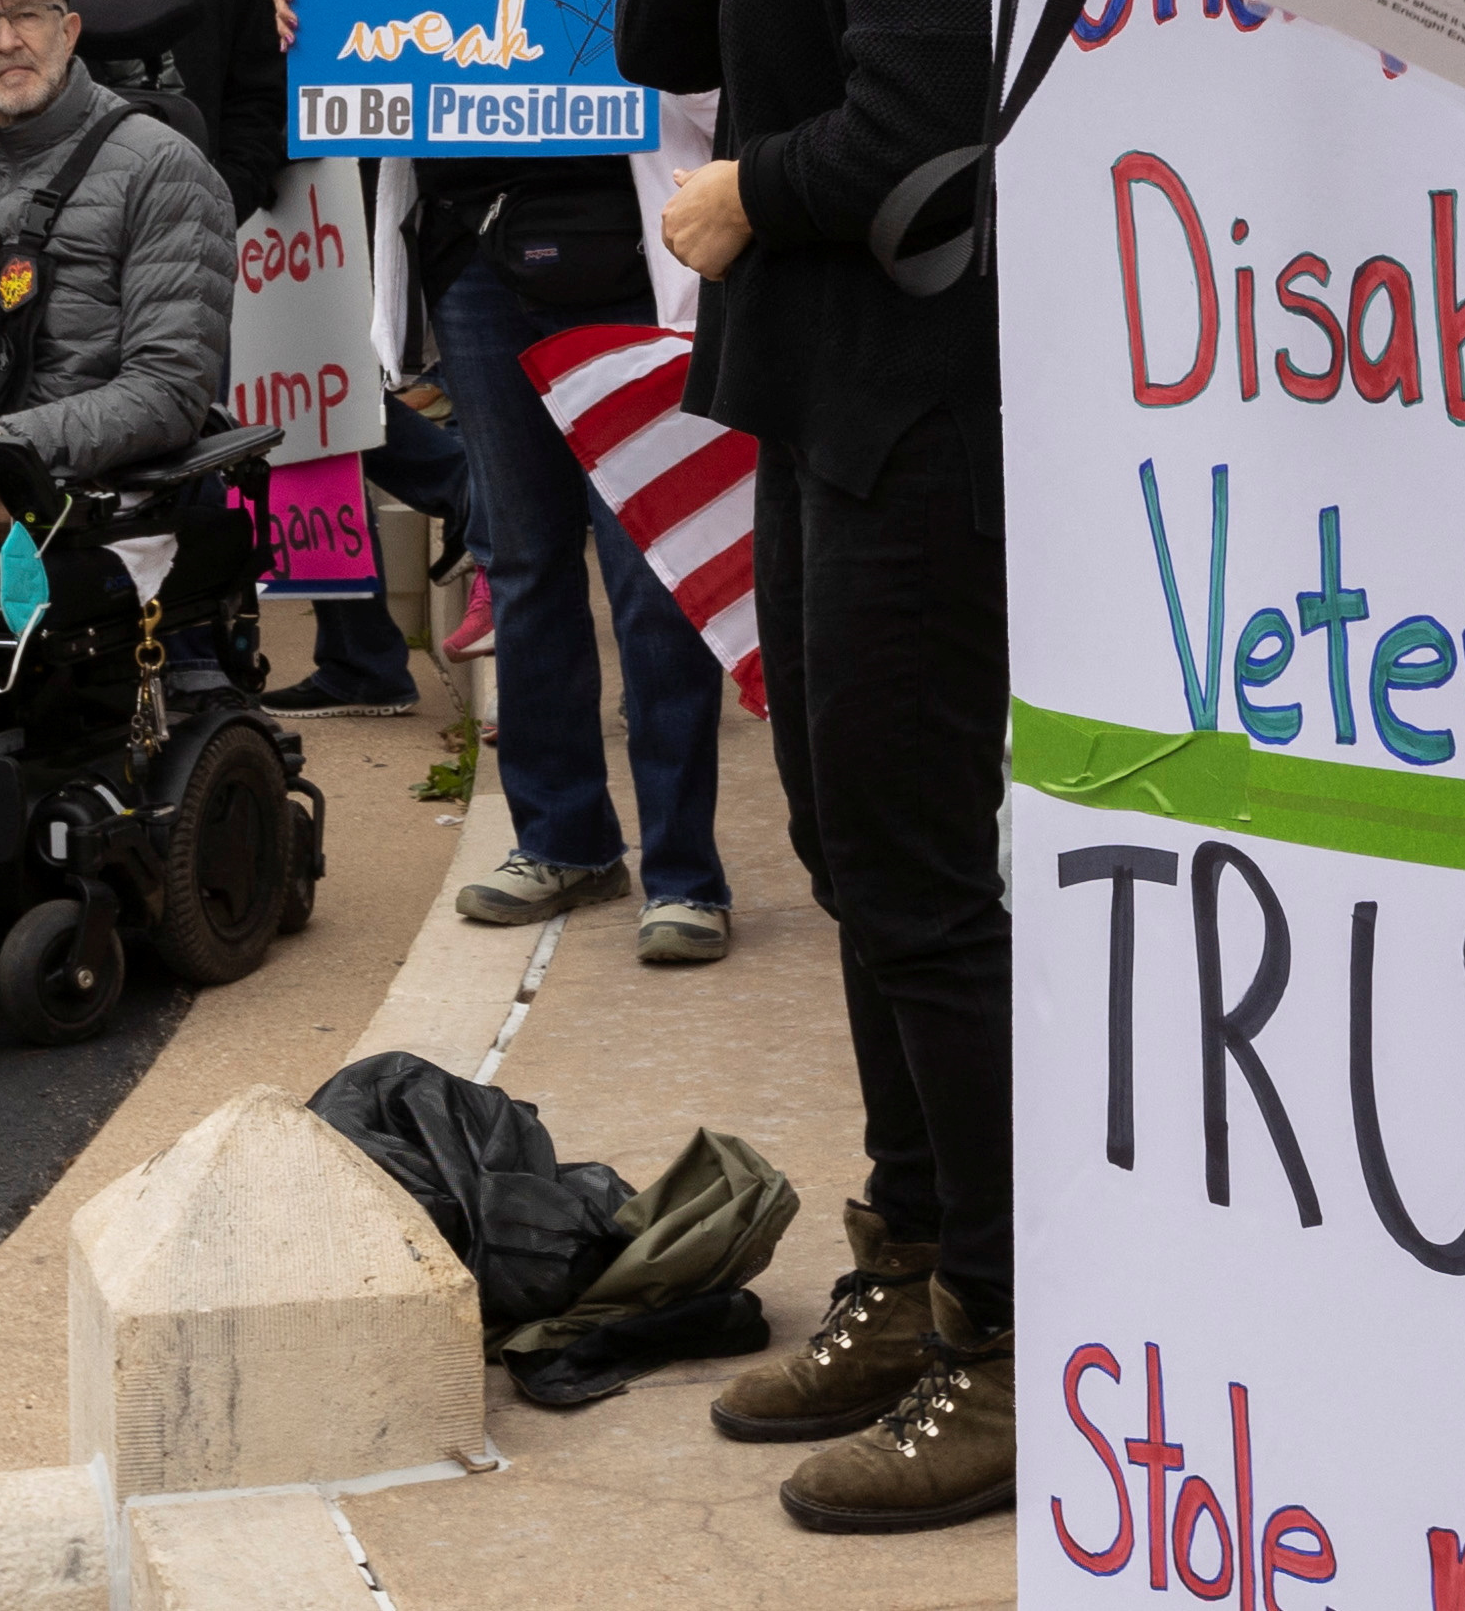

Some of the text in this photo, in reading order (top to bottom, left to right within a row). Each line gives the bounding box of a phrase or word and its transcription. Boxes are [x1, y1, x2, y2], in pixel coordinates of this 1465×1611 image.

[1391, 1, 1444, 32] Enough!
[1449, 15, 1459, 26] it
[301, 87, 640, 136] To Be President
[1050, 1341, 1337, 1611] Stole
